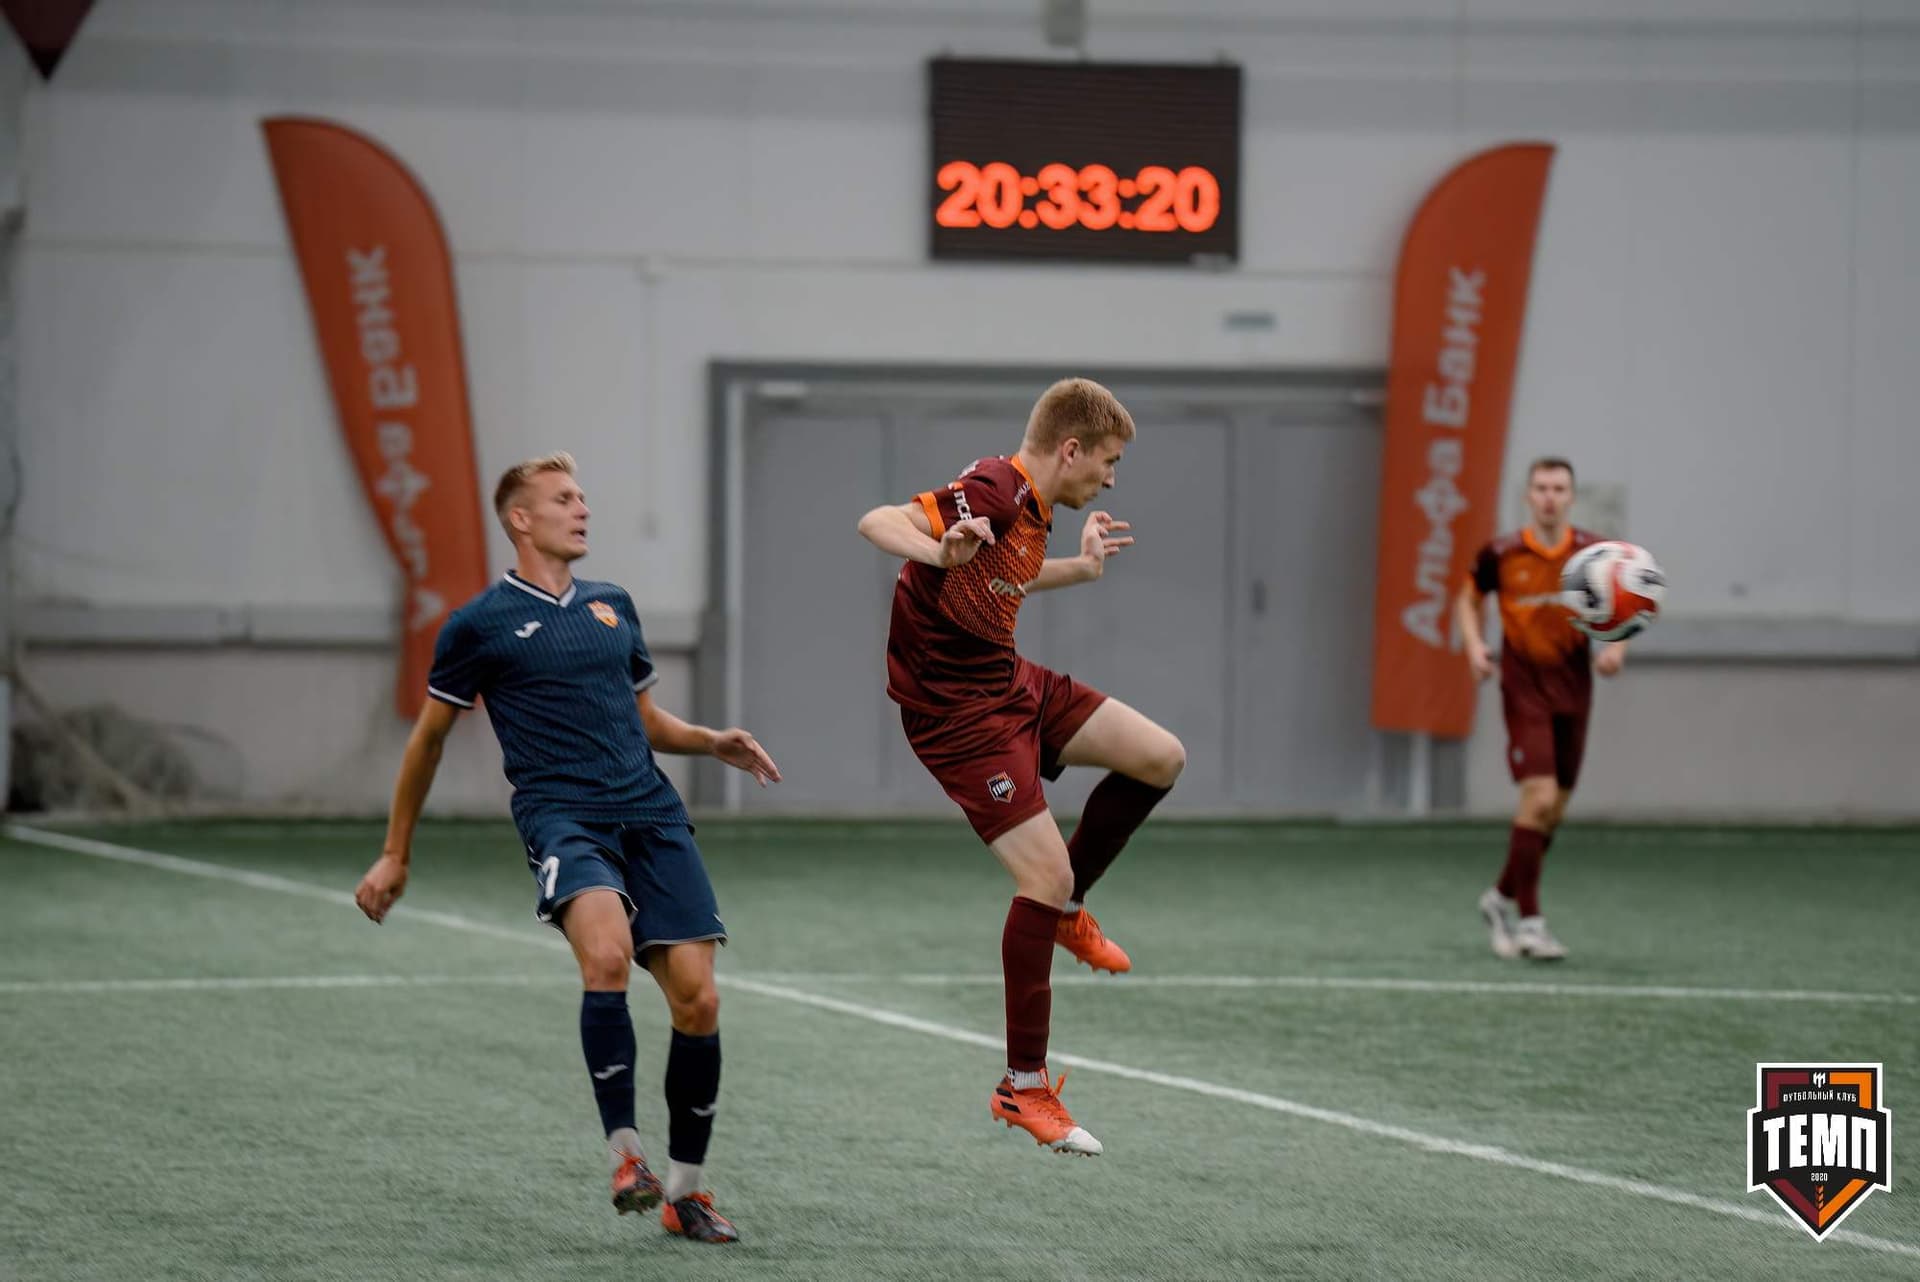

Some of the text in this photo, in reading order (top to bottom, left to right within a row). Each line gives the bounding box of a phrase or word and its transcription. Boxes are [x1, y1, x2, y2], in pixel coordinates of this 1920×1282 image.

[936, 161, 1220, 232] 20:33:20
[1403, 264, 1487, 649] Альфа Банк
